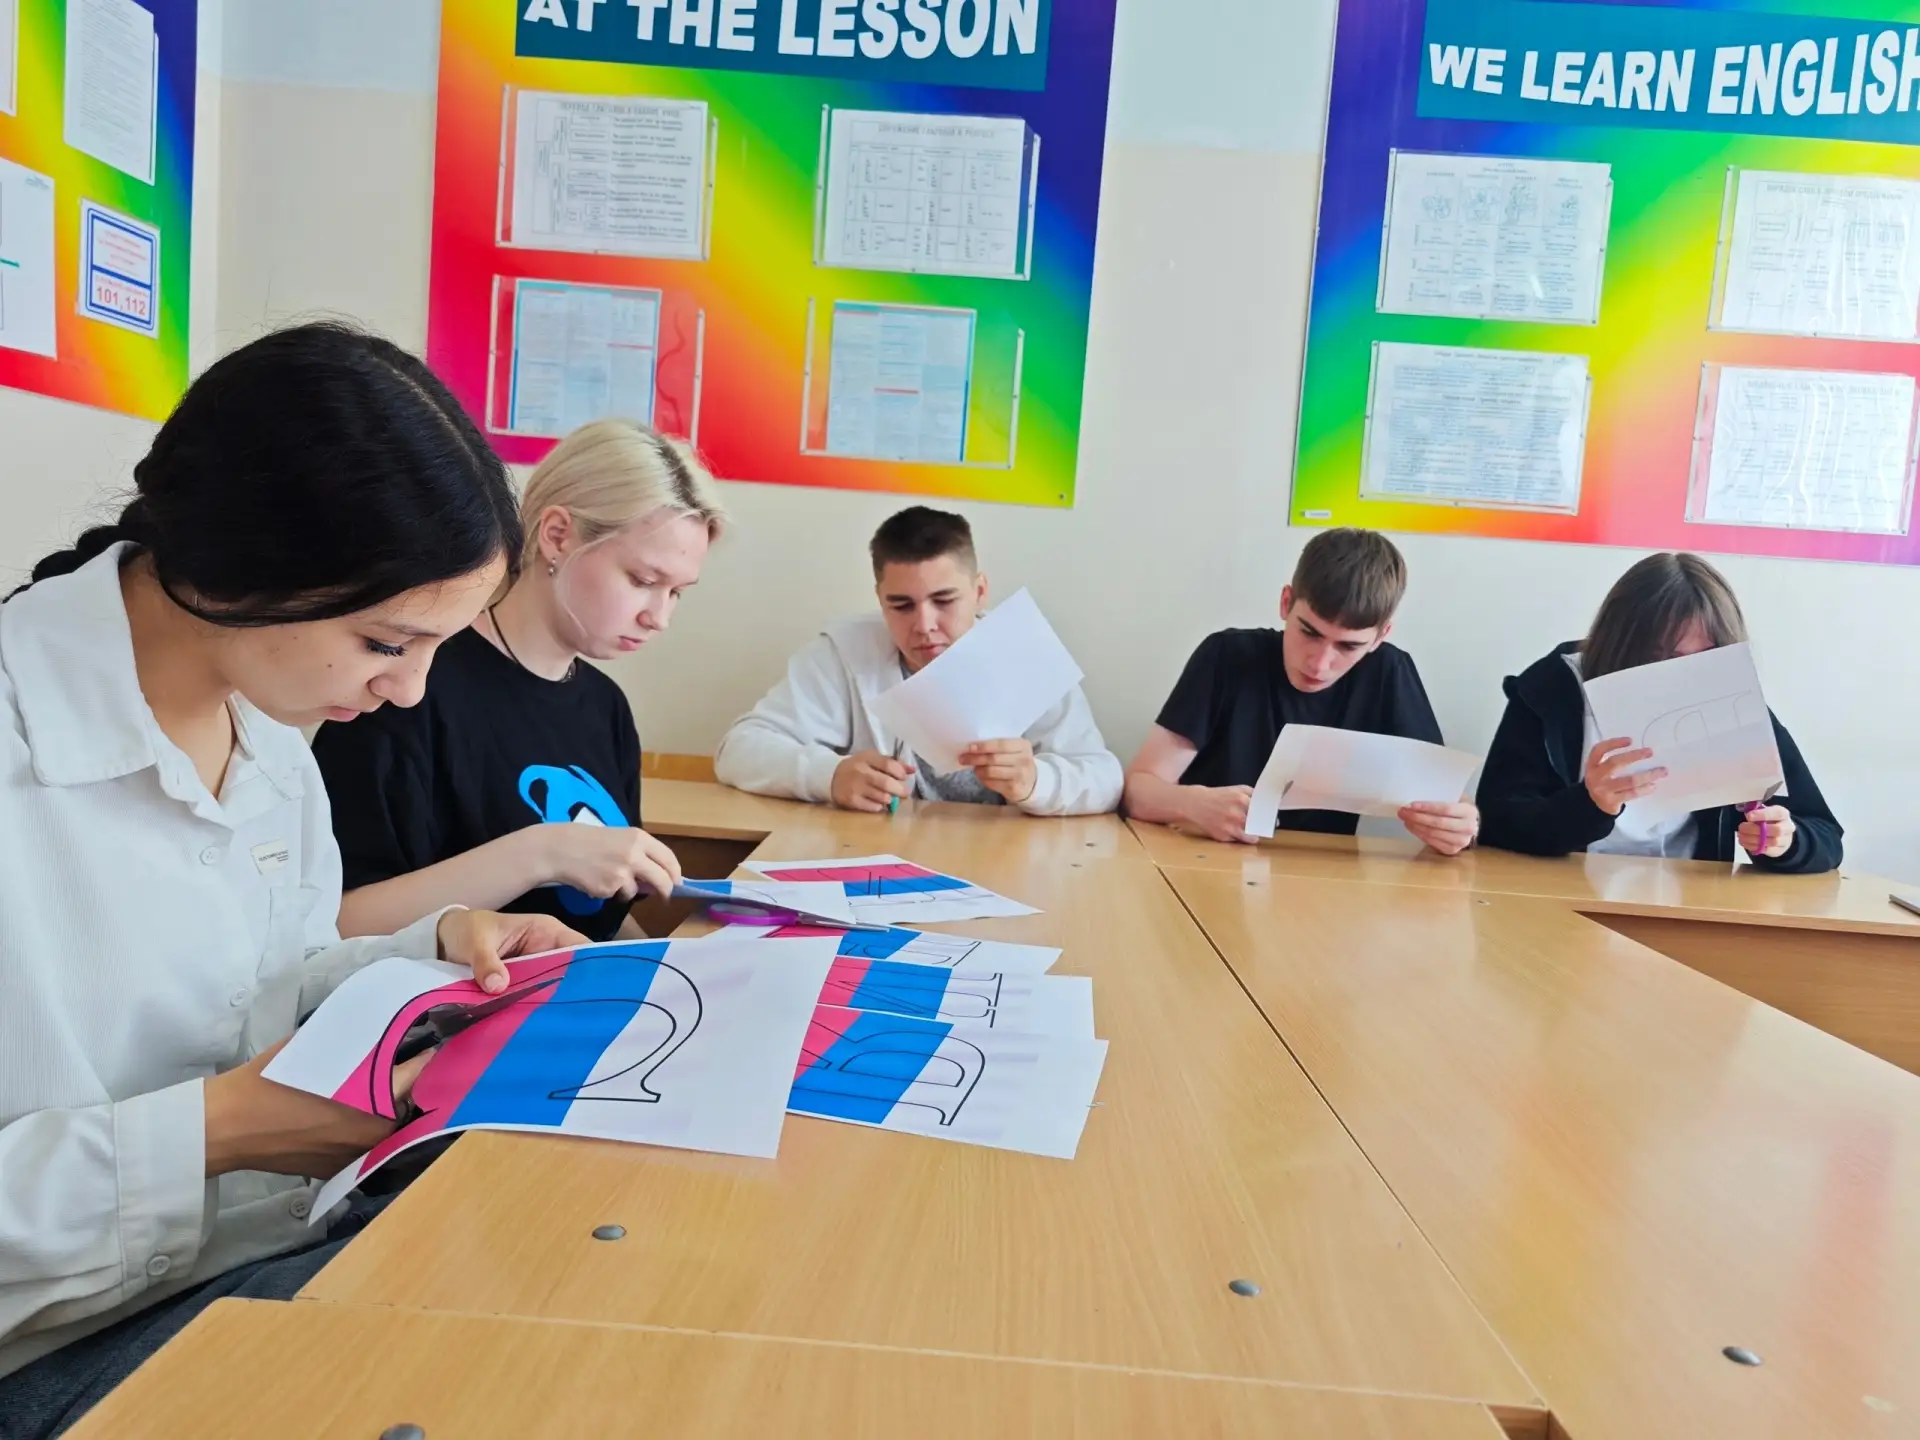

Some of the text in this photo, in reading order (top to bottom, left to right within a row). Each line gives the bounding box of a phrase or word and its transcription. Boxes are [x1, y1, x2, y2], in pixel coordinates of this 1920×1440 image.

[523, 0, 1039, 59] AT THE LESSON
[1429, 28, 1920, 116] WE LEARN ENGLISH
